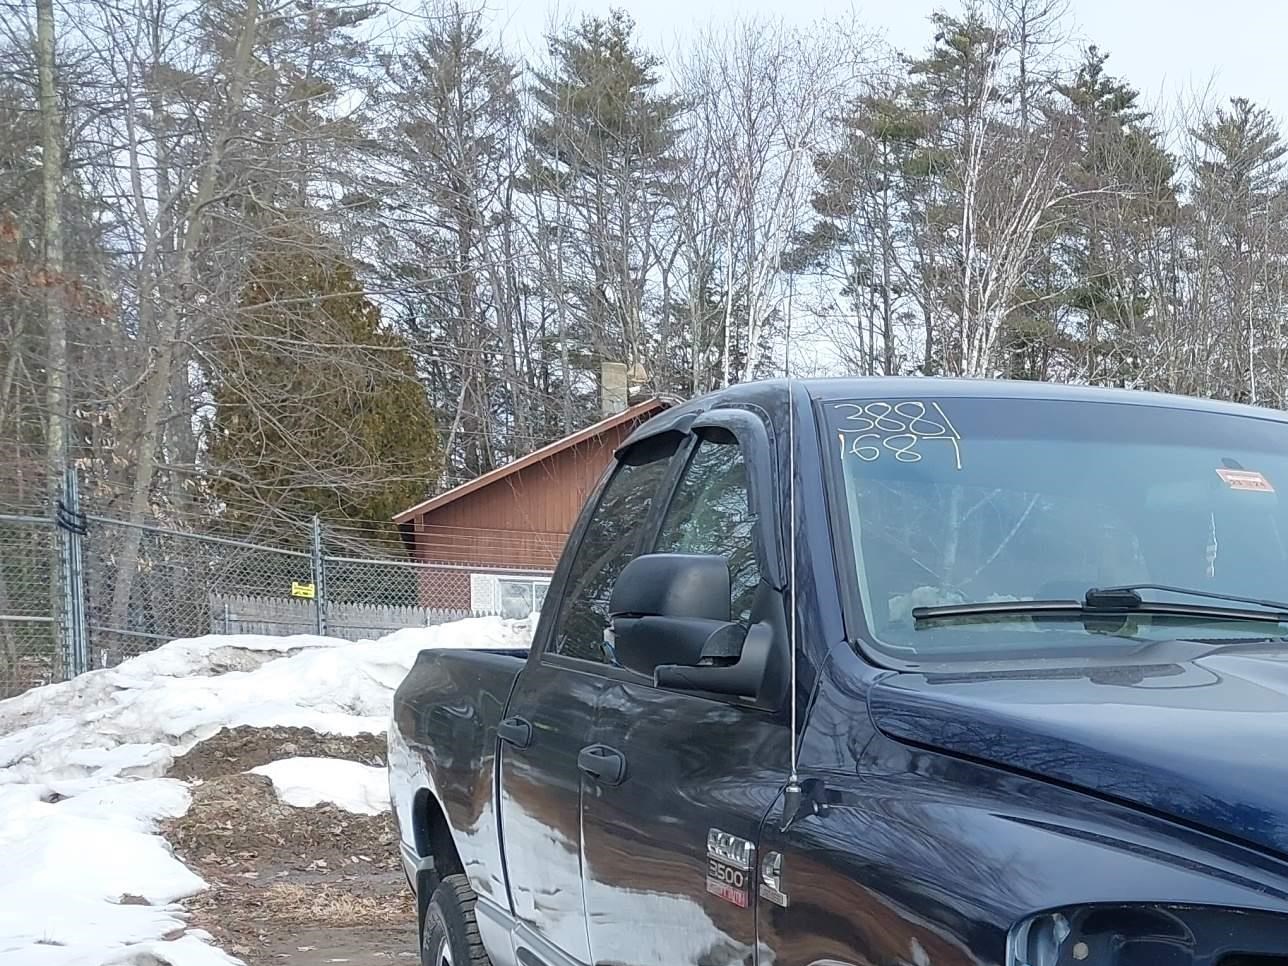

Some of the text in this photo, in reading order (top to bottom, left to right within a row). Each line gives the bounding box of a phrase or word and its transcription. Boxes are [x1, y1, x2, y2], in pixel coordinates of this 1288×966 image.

[834, 402, 961, 440] 3881
[838, 433, 962, 470] 1687
[709, 860, 745, 888] 3500
